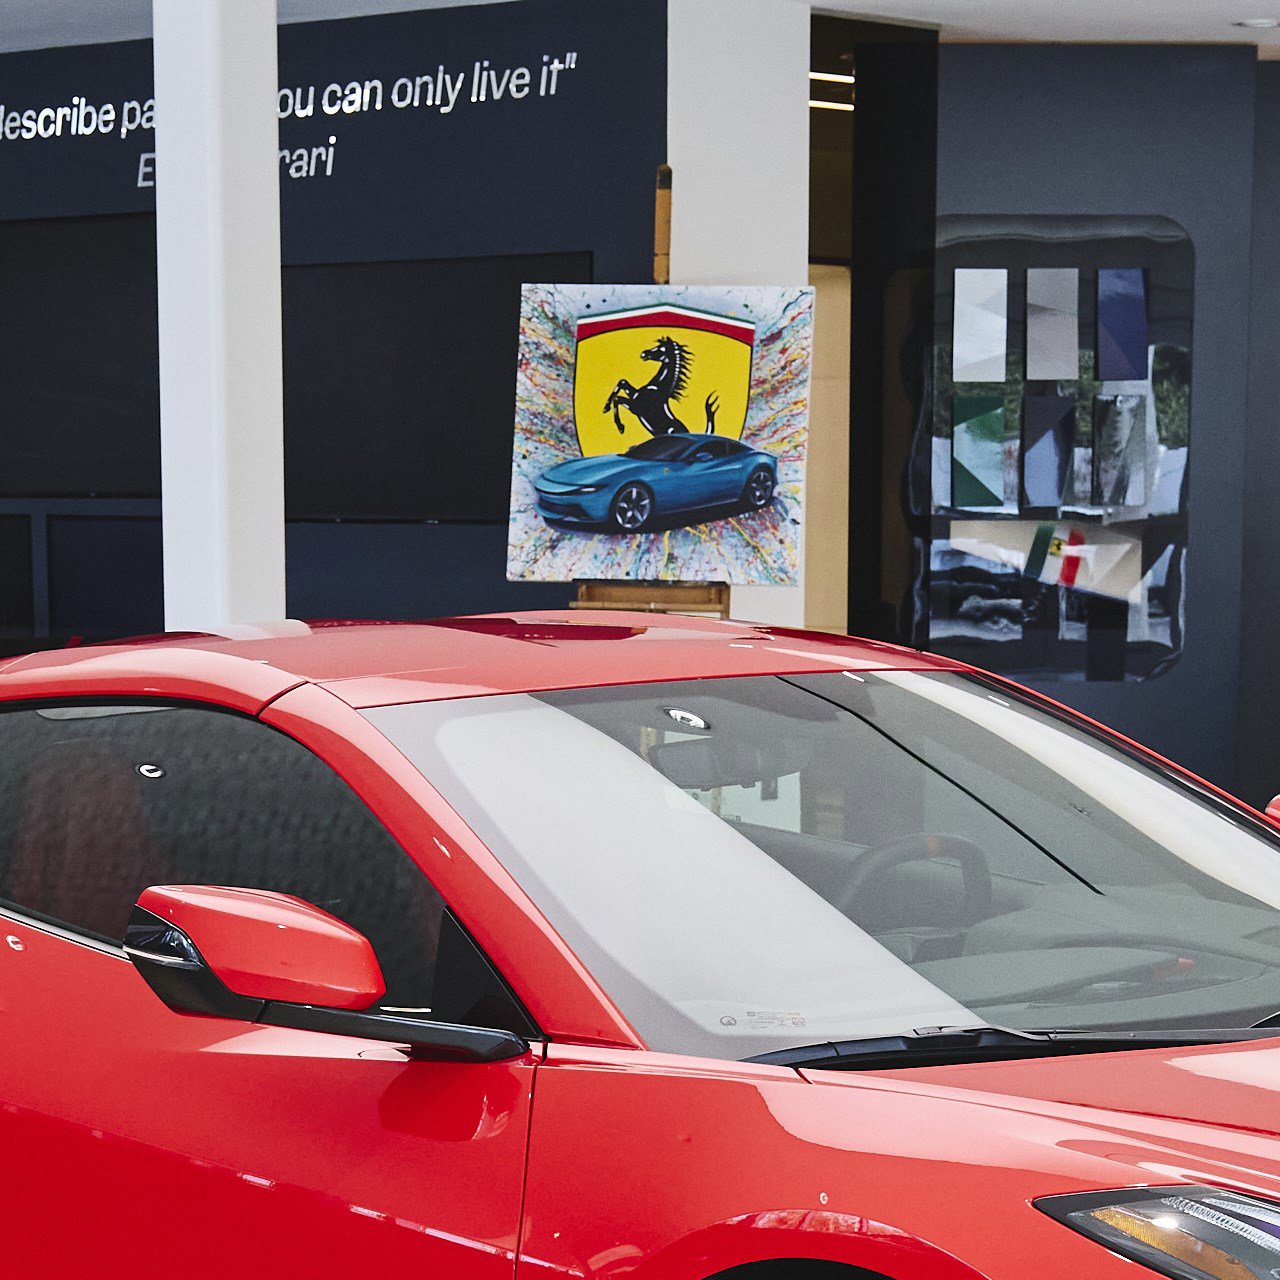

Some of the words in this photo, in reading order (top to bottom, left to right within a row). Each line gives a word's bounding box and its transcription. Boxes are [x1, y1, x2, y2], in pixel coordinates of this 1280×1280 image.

[278, 86, 315, 119] ou
[322, 80, 384, 116] can
[391, 65, 466, 115] only
[471, 60, 532, 103] live
[540, 52, 578, 97] it"
